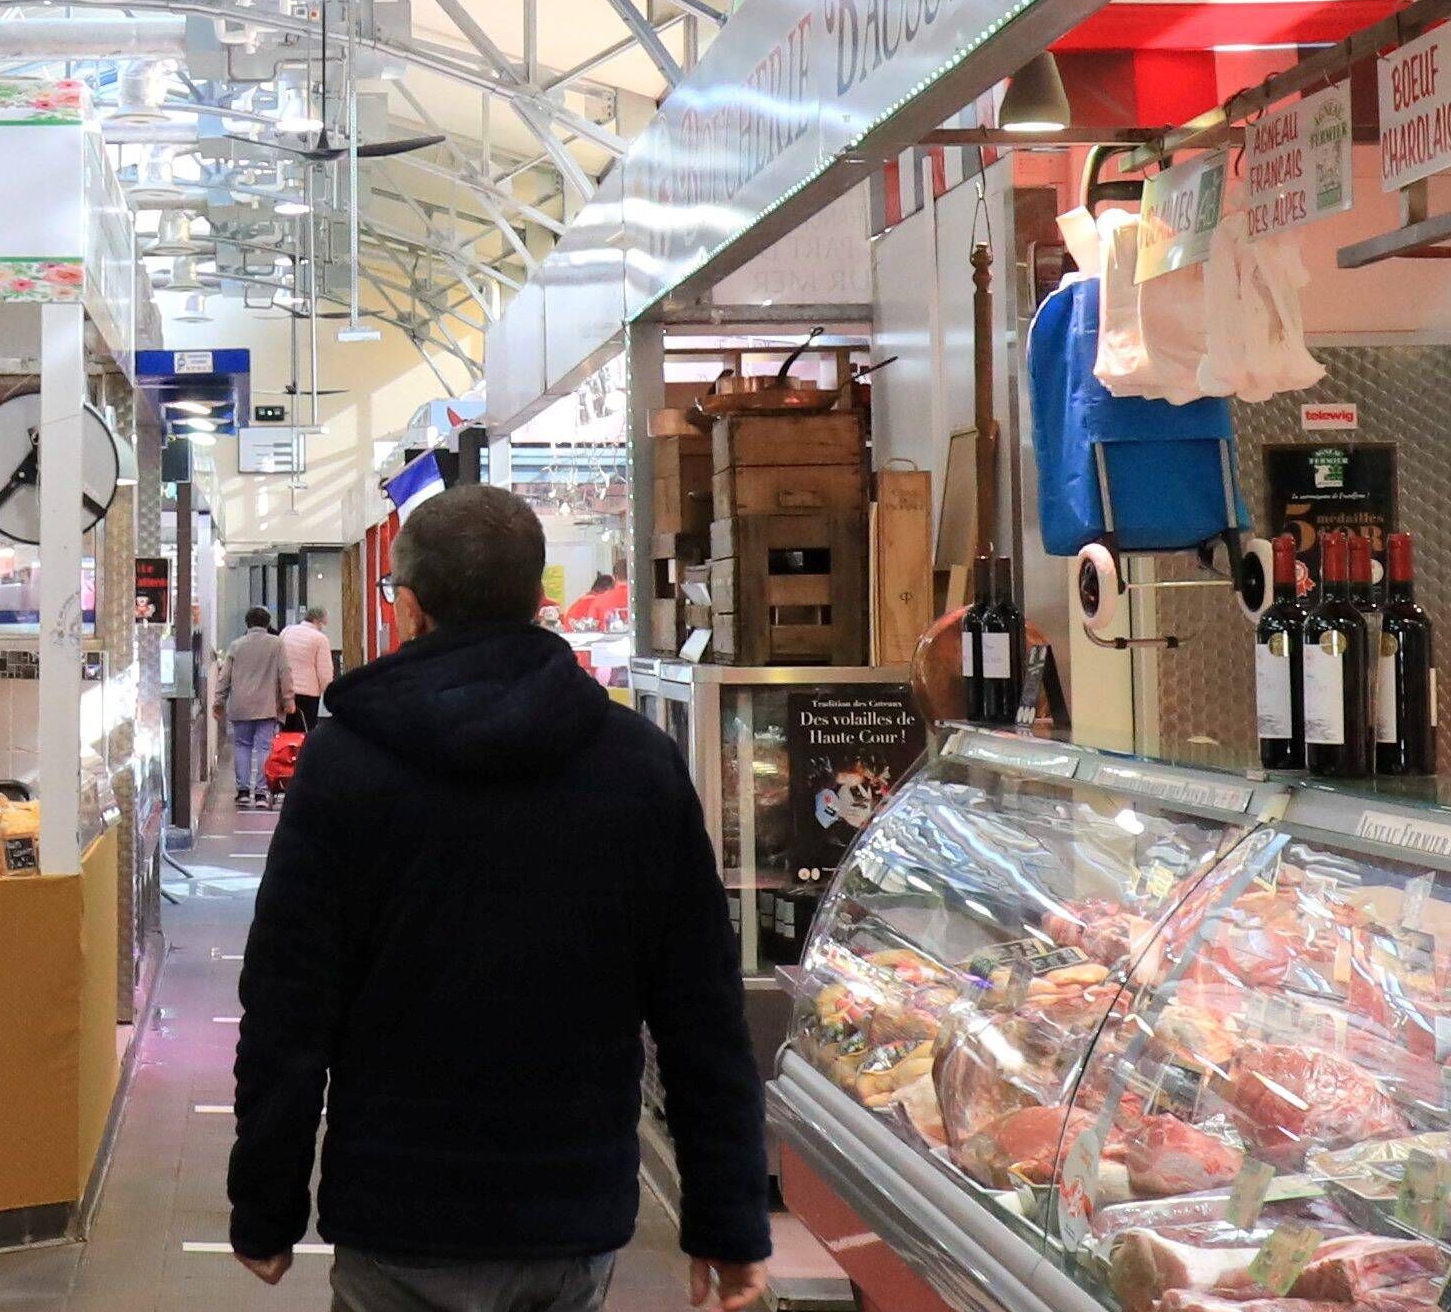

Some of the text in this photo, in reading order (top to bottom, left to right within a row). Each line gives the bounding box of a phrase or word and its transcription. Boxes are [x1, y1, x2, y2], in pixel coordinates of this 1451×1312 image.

[1392, 45, 1438, 112] BOEUF
[1254, 112, 1299, 155] AGNEAU
[1247, 189, 1306, 237] DES ALPES
[800, 711, 915, 727] Des volailles de
[810, 729, 855, 744] Haute
[859, 729, 898, 744] Cour
[1359, 815, 1399, 842] AGNEAU
[1400, 823, 1449, 857] FERMIER
